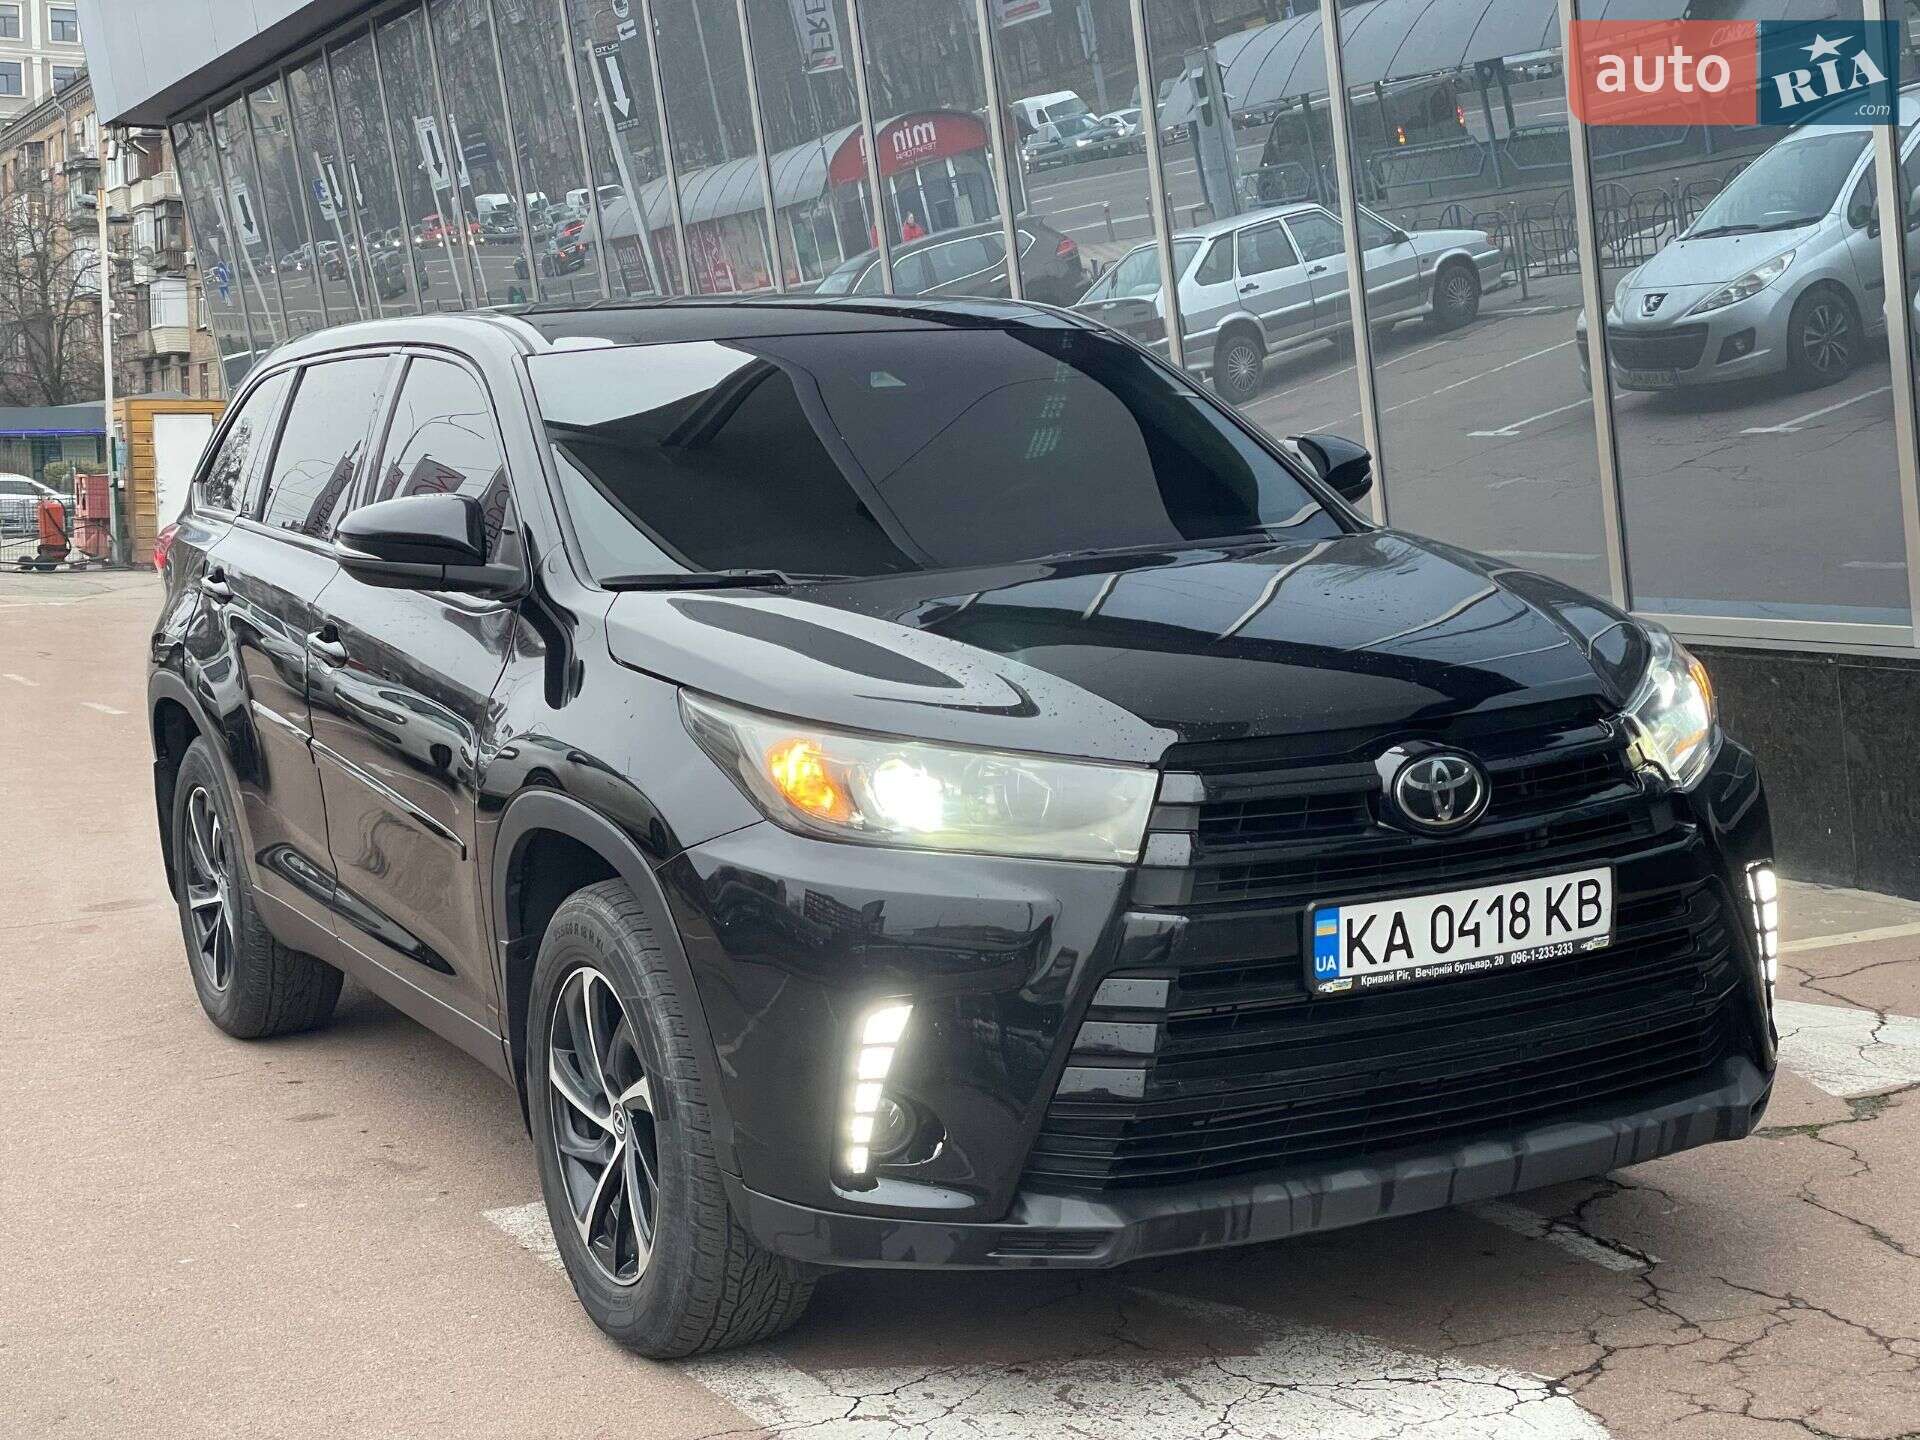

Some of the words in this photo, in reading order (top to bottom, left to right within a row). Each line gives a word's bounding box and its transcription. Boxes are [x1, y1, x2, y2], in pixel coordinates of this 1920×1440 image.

[1346, 911, 1415, 968] KA
[1430, 891, 1531, 954] 0418
[1545, 878, 1602, 937] KB
[1316, 955, 1337, 972] UA
[1360, 971, 1395, 987] Кривий
[1396, 970, 1411, 982] Ріг,
[1415, 964, 1453, 978] Вечірній
[1454, 959, 1493, 975] бульвар,
[1494, 955, 1504, 965] 20
[1511, 942, 1574, 965] 096-1-233-233
